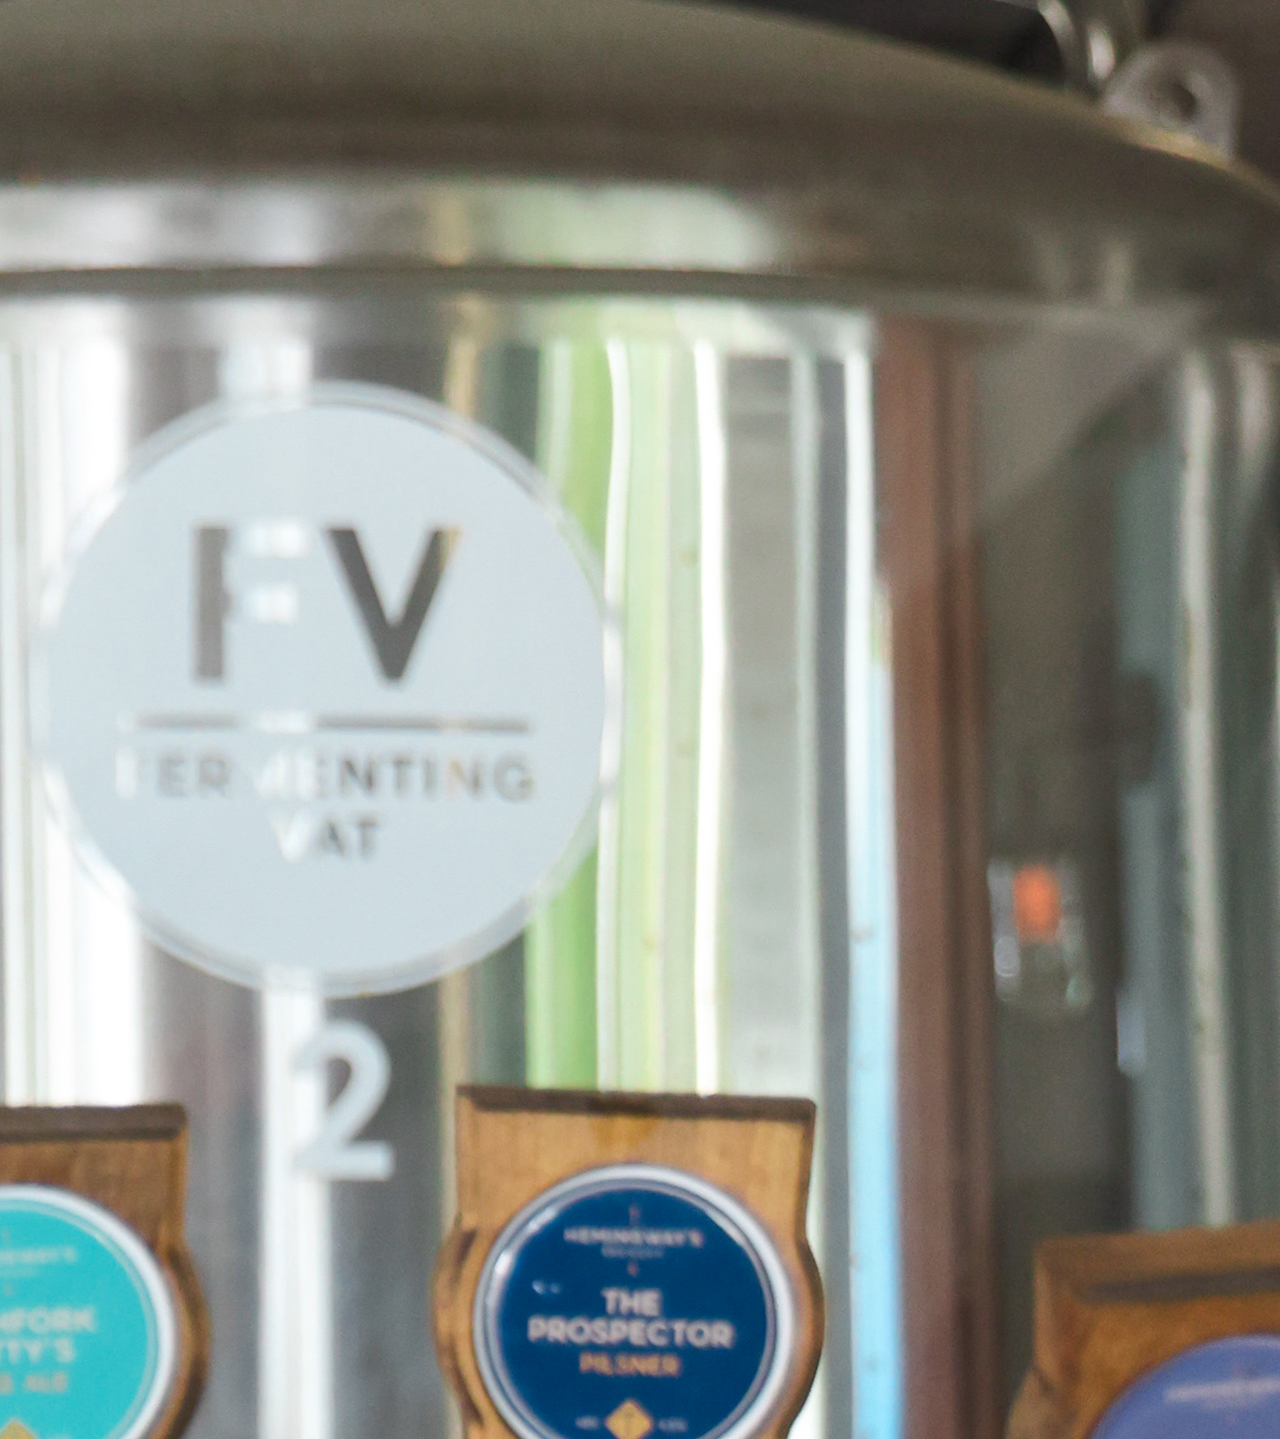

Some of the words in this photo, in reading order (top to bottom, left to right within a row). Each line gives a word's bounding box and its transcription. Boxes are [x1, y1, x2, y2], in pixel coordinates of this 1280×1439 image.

[192, 519, 462, 683] FV
[272, 812, 381, 864] VAT
[295, 1019, 395, 1182] 2
[600, 1287, 662, 1317] THE
[527, 1315, 736, 1349] PROSPECTOR
